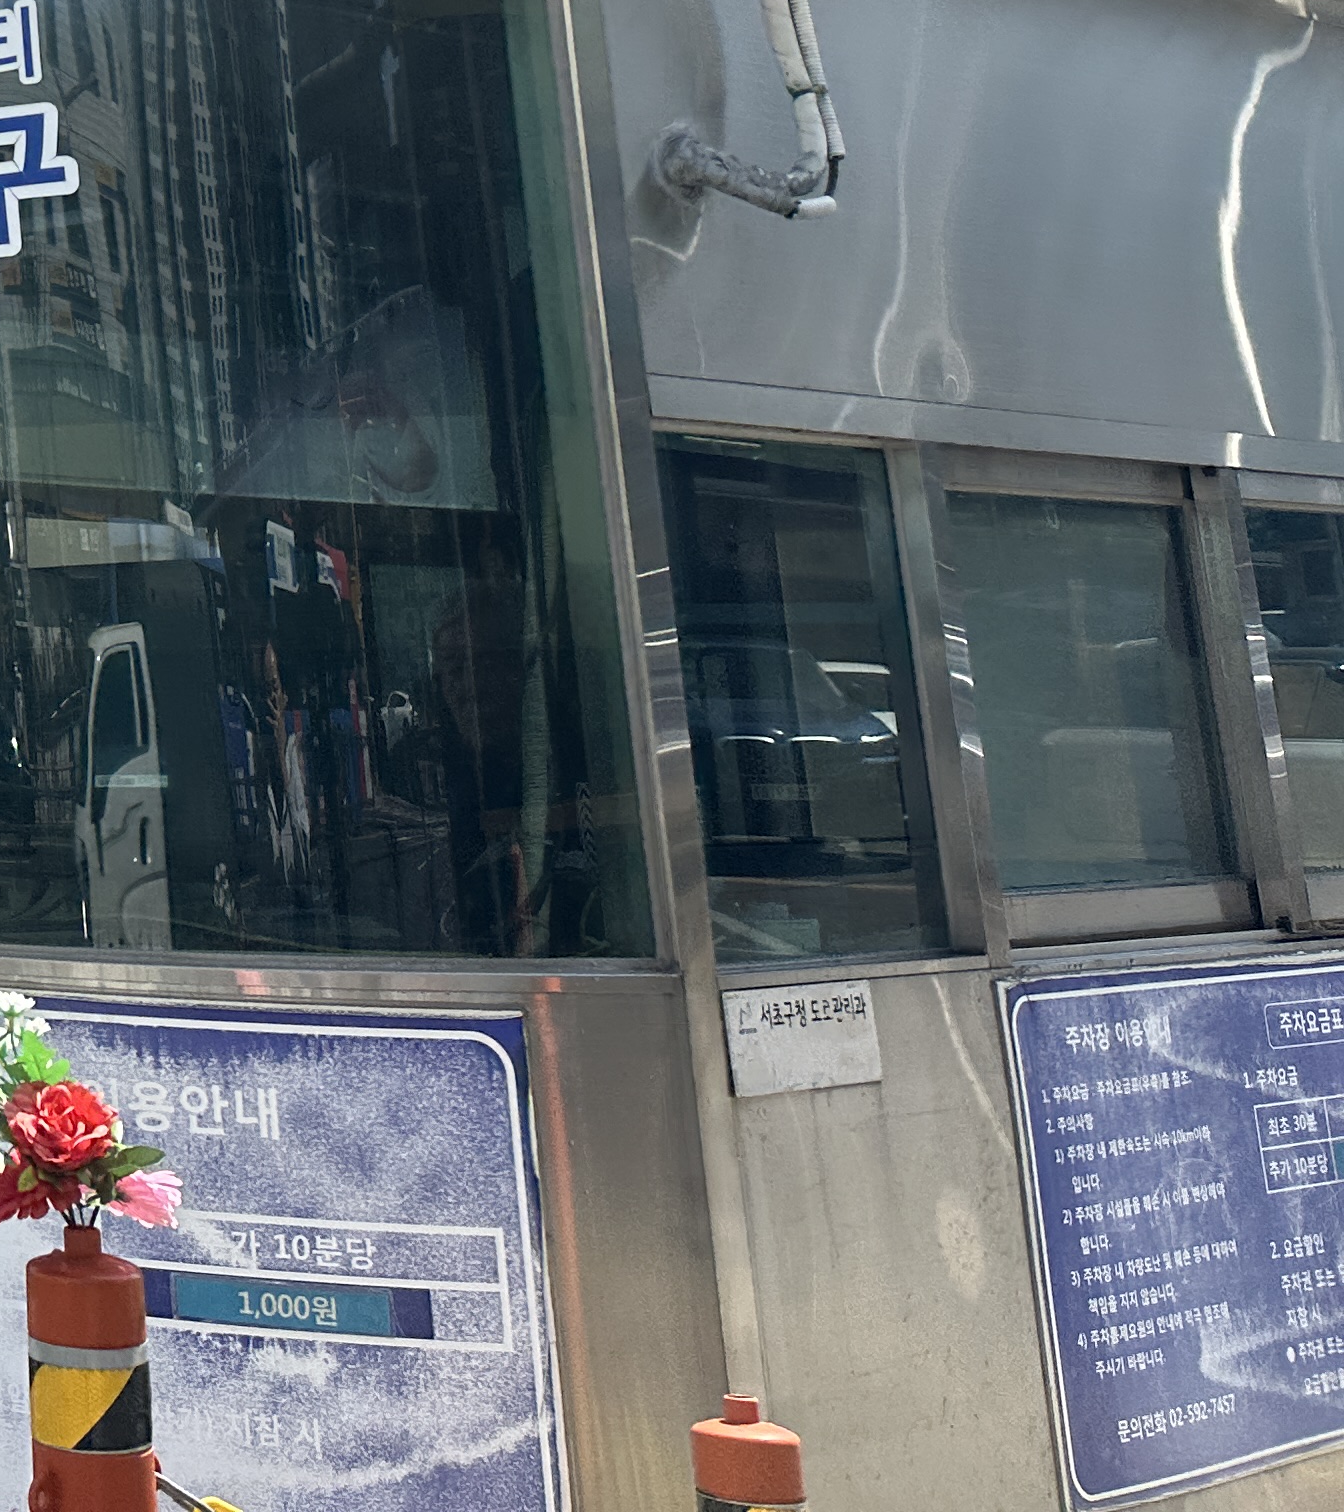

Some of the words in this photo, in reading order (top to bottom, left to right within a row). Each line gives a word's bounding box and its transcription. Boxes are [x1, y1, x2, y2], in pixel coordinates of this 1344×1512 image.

[760, 999, 807, 1029] 서초구청
[1279, 1008, 1344, 1038] 주차요금표
[1065, 1022, 1110, 1054] 주차장
[1256, 1065, 1299, 1091] 주차요금
[1052, 1083, 1090, 1104] 주차요금
[113, 1078, 280, 1140] 용안내
[1057, 1113, 1094, 1135] 주의사항
[1268, 1115, 1291, 1137] 최초
[1293, 1113, 1318, 1133] 30분
[1055, 1150, 1064, 1164] 1)
[1067, 1145, 1095, 1165] 주차장
[1097, 1143, 1107, 1159] 내
[1269, 1159, 1292, 1182] 추가
[1294, 1153, 1329, 1176] 10분당
[1062, 1210, 1073, 1226] 2)
[1075, 1203, 1103, 1224] 주차장
[273, 1233, 377, 1271] 10분당
[1283, 1232, 1325, 1258] 요금할인
[1070, 1271, 1080, 1287] 3)
[1083, 1265, 1112, 1286] 주차장
[1114, 1262, 1124, 1279] 내
[1127, 1254, 1161, 1277] 차량도난
[1281, 1270, 1313, 1296] 주차권
[1314, 1267, 1336, 1288] 또는
[238, 1291, 338, 1328] 1,000원
[1088, 1295, 1118, 1316] 책임을
[1119, 1290, 1138, 1310] 지지
[1077, 1333, 1088, 1350] 4)
[1298, 1338, 1326, 1363] 주차권
[1095, 1356, 1125, 1380] 주시기
[1117, 1410, 1167, 1443] 문의전화
[1169, 1393, 1236, 1428] 02-592-7457
